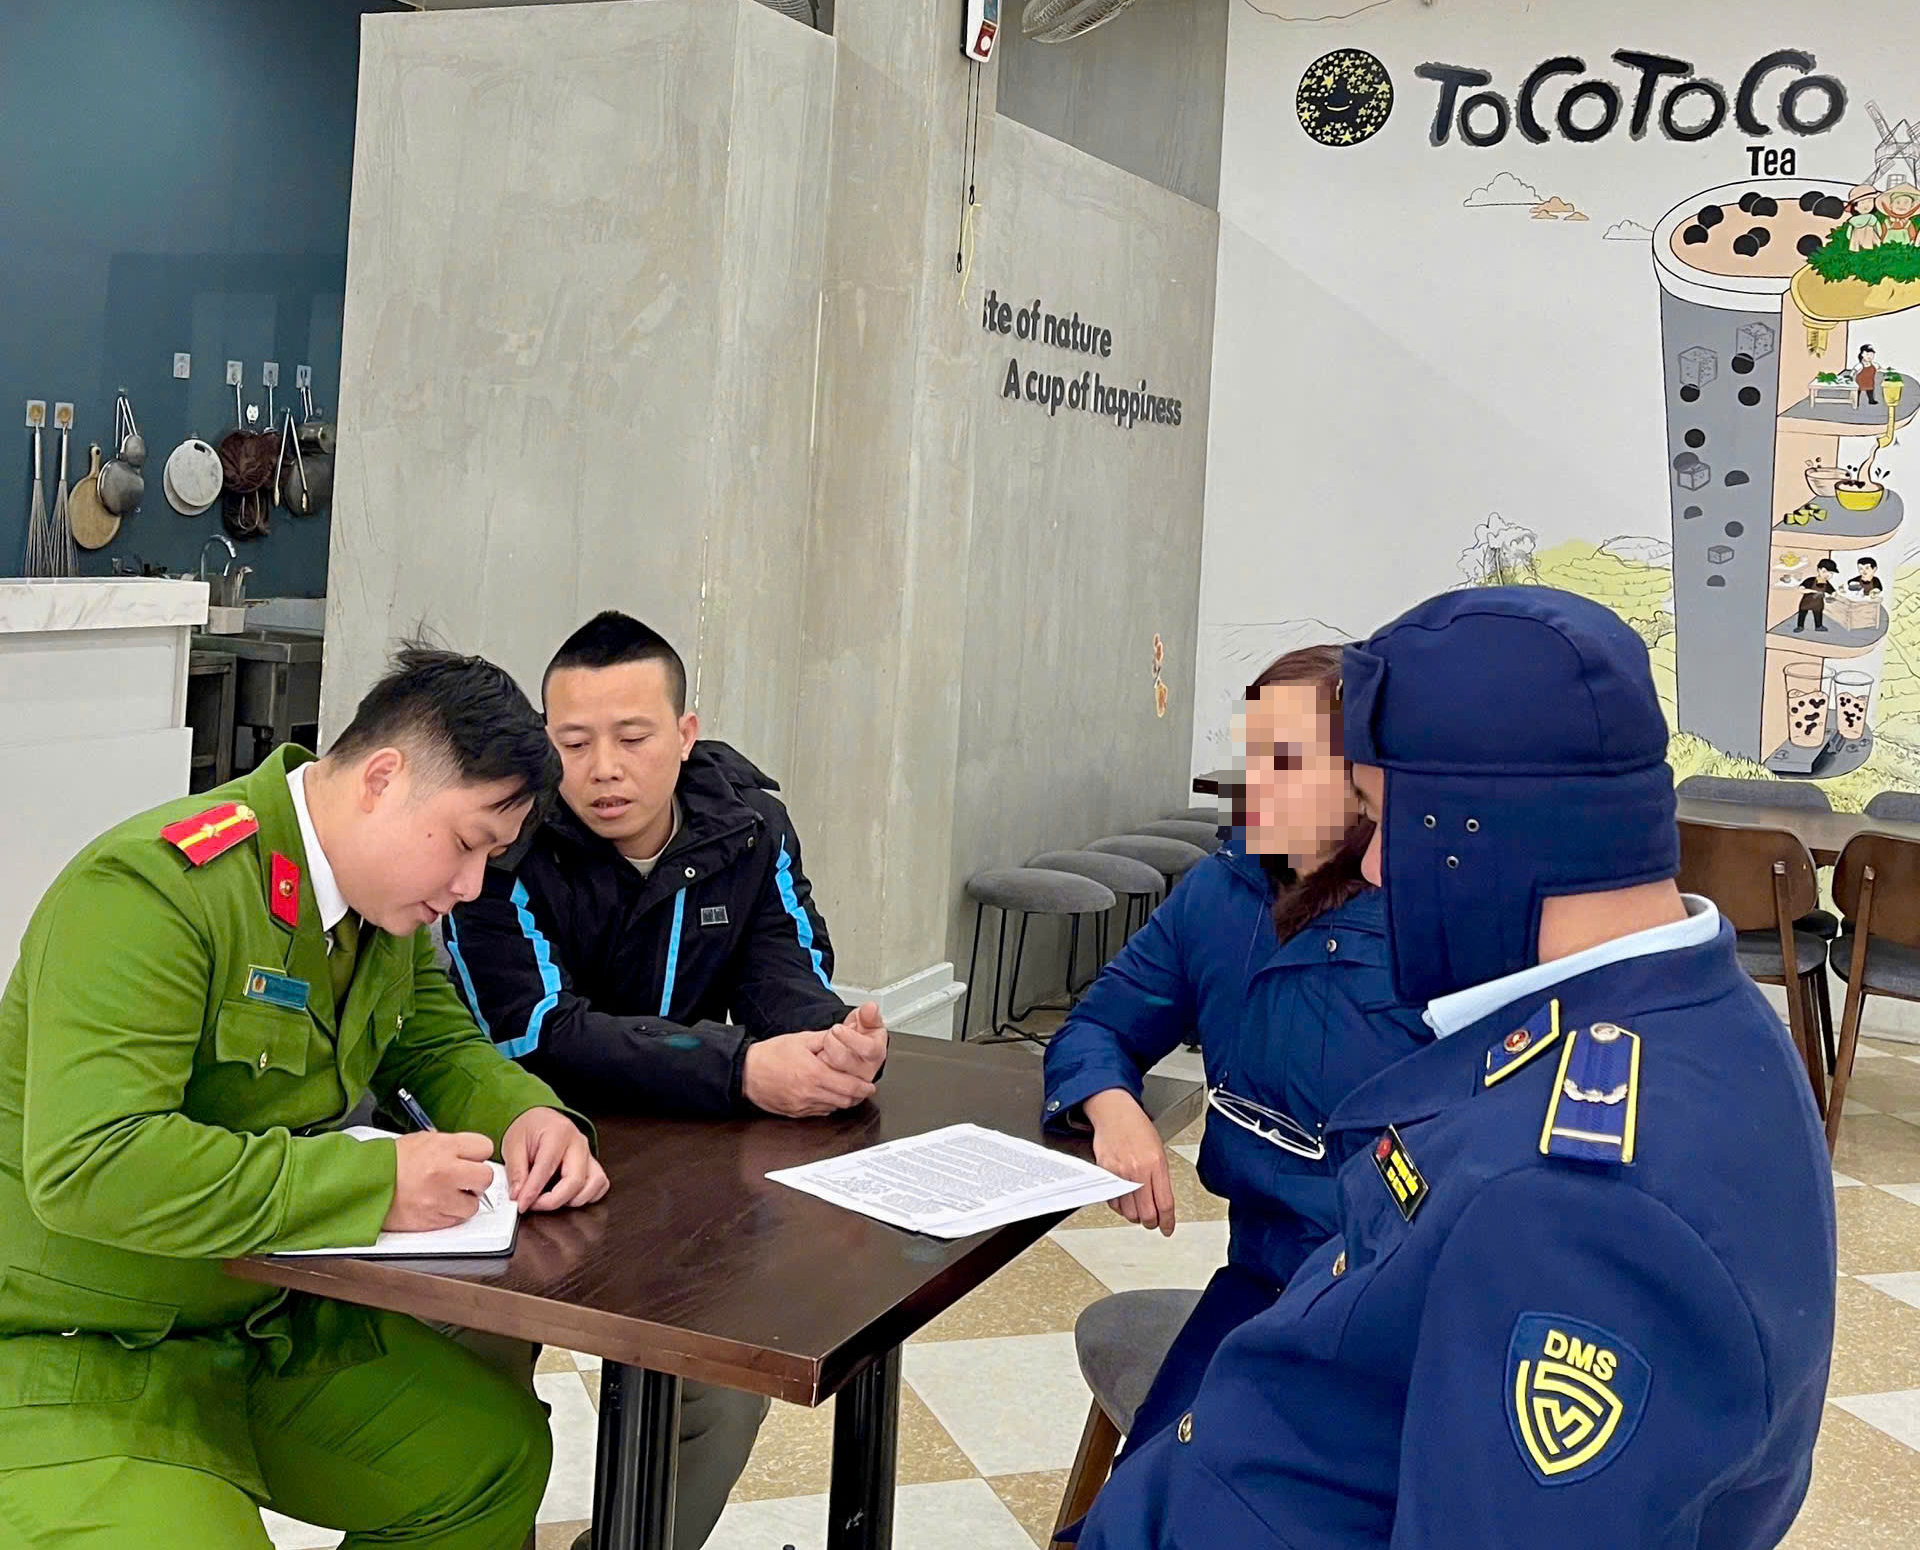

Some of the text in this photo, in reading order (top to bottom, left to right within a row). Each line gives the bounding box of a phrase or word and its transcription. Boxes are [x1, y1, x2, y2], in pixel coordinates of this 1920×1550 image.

[1747, 146, 1796, 176] Tea
[1016, 299, 1042, 341] of
[1042, 311, 1113, 358] nature
[1002, 357, 1183, 429] A cup of happiness
[1543, 1328, 1618, 1382] DMS
